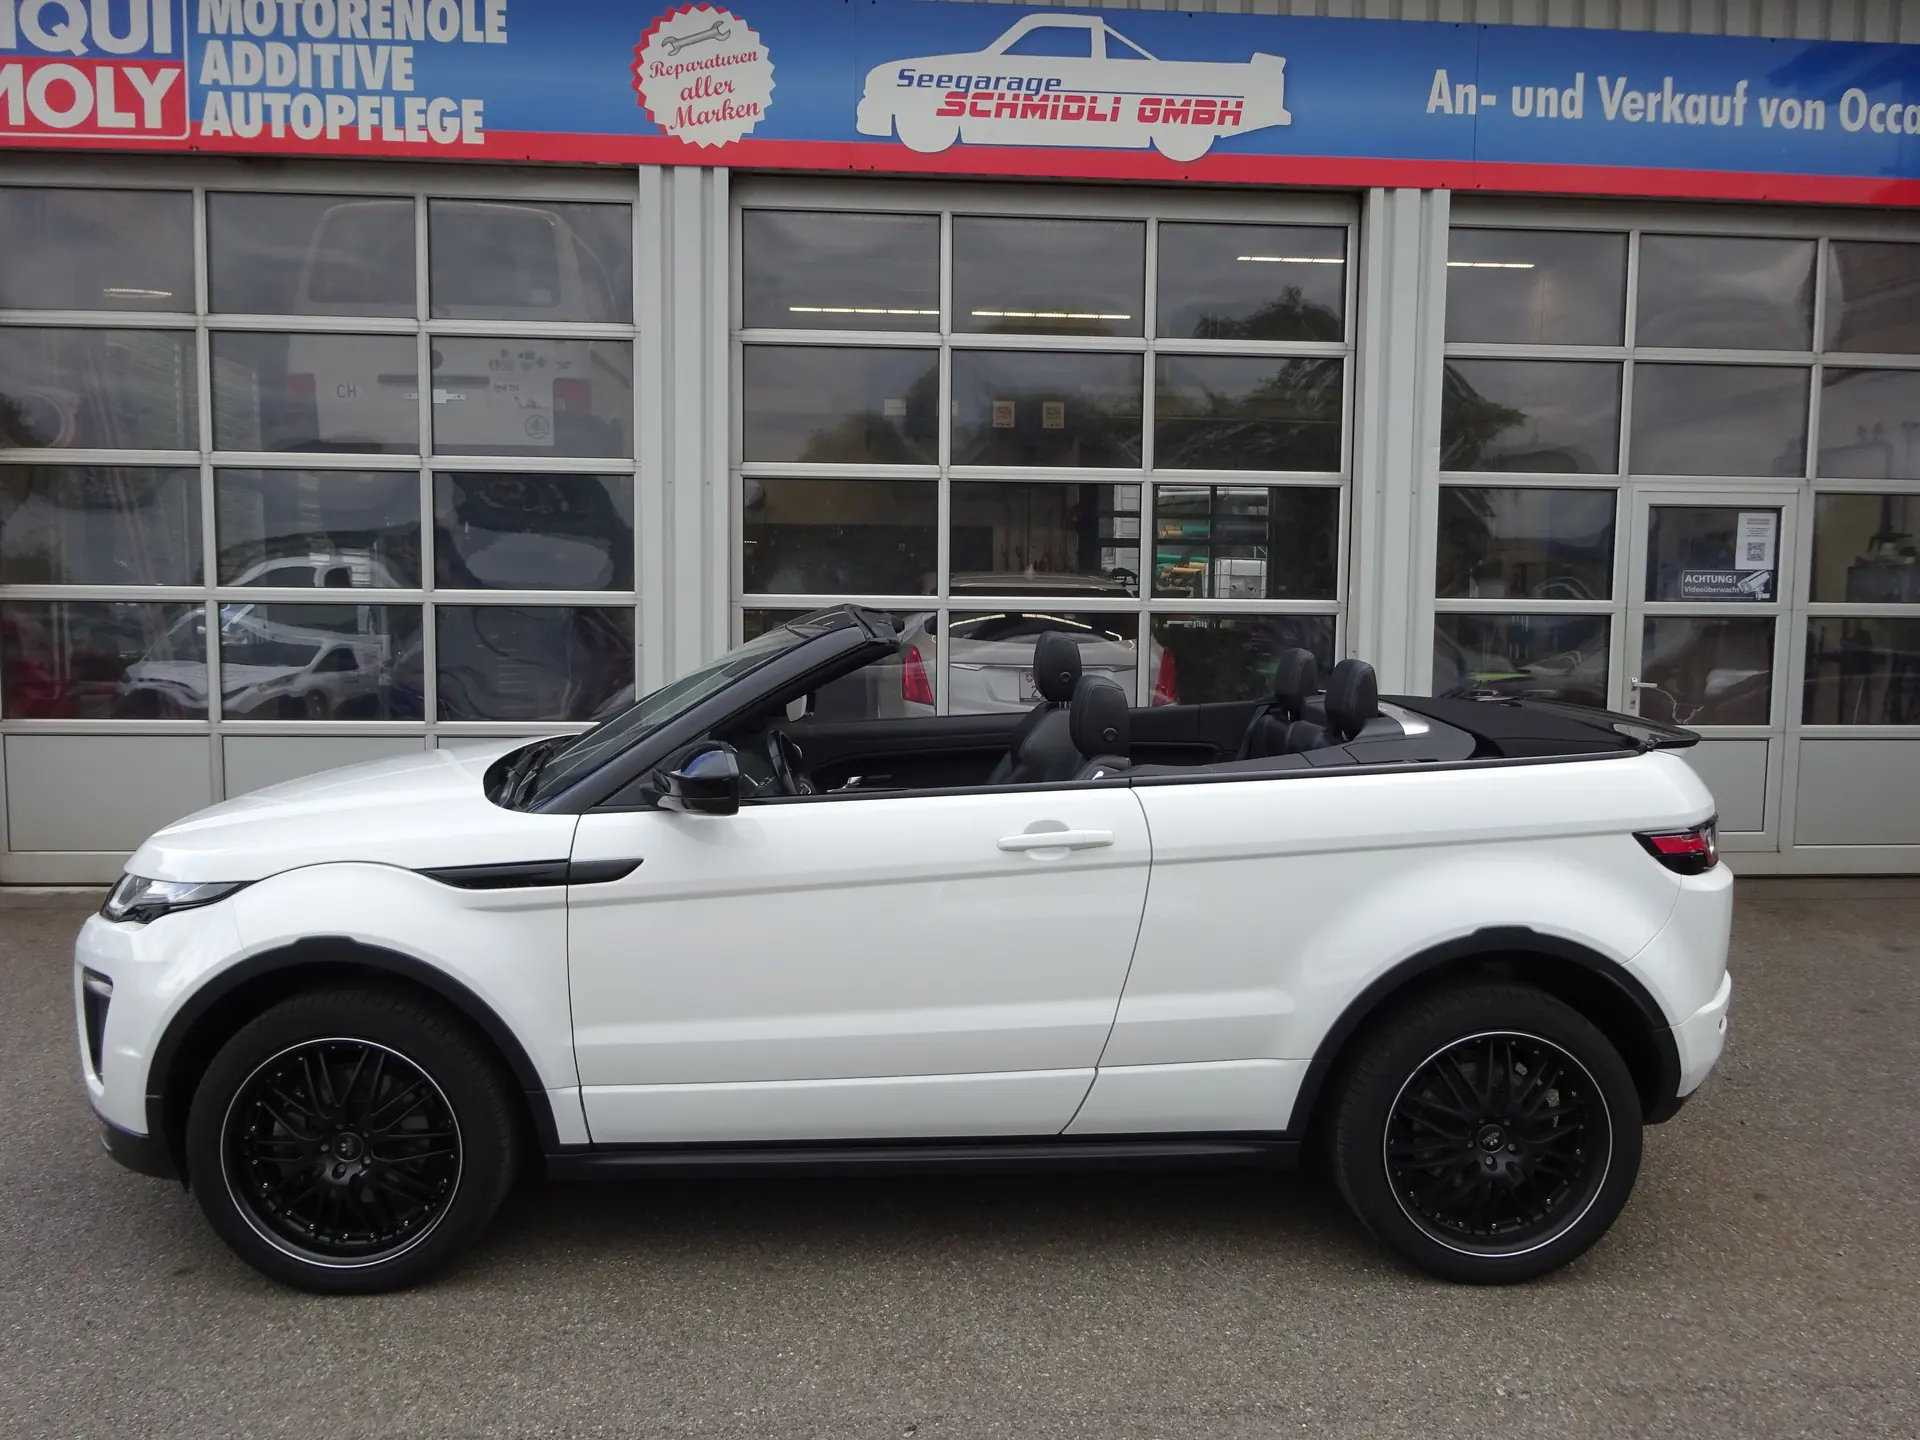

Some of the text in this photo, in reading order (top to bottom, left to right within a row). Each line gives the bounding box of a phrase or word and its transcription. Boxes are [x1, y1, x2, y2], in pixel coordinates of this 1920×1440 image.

[199, 40, 415, 91] ADDITIVE
[649, 51, 760, 80] Reparaturen
[680, 75, 736, 101] aller
[896, 68, 1062, 96] Seegarage
[669, 98, 761, 130] Marken
[936, 91, 1245, 126] SCHMIDLI GMBH
[1426, 69, 1497, 115] An-
[1511, 72, 1585, 119] und
[1597, 76, 1749, 127] Verkauf
[1758, 97, 1826, 130] von
[200, 91, 485, 144] AUTOPFLEGE
[336, 381, 357, 399] CH
[1684, 574, 1737, 584] ACHTUNG!
